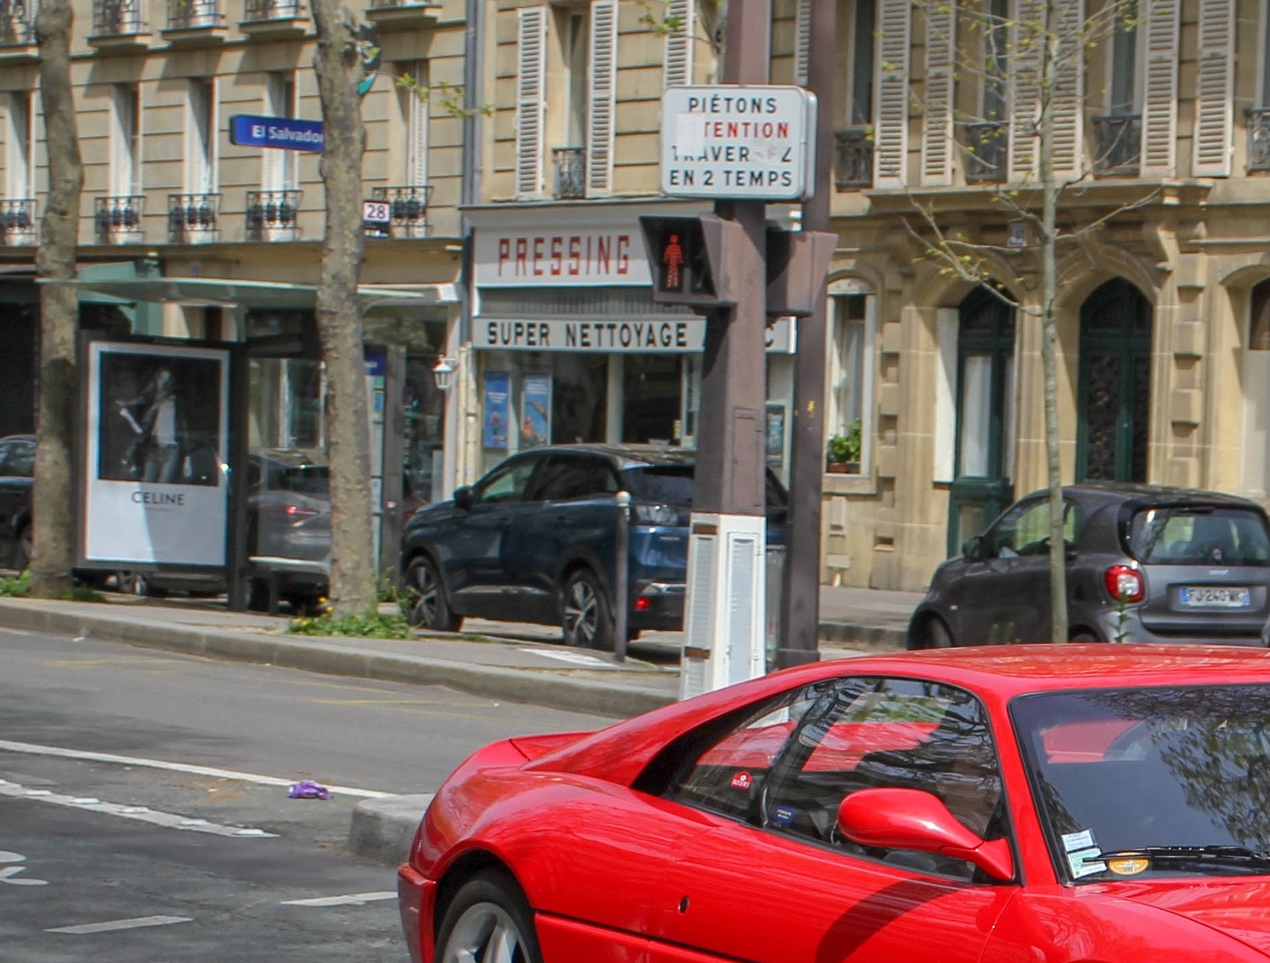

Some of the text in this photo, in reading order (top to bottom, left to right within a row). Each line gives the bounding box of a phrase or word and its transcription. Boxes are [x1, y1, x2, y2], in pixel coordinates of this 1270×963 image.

[688, 93, 777, 114] PIÉTONS
[252, 125, 265, 138] El
[669, 169, 793, 187] EN 2 TEMPS
[366, 204, 386, 219] 28
[498, 234, 630, 276] PRESSING
[487, 321, 688, 347] SUPER NETTOYAGE
[131, 490, 186, 506] CELINE
